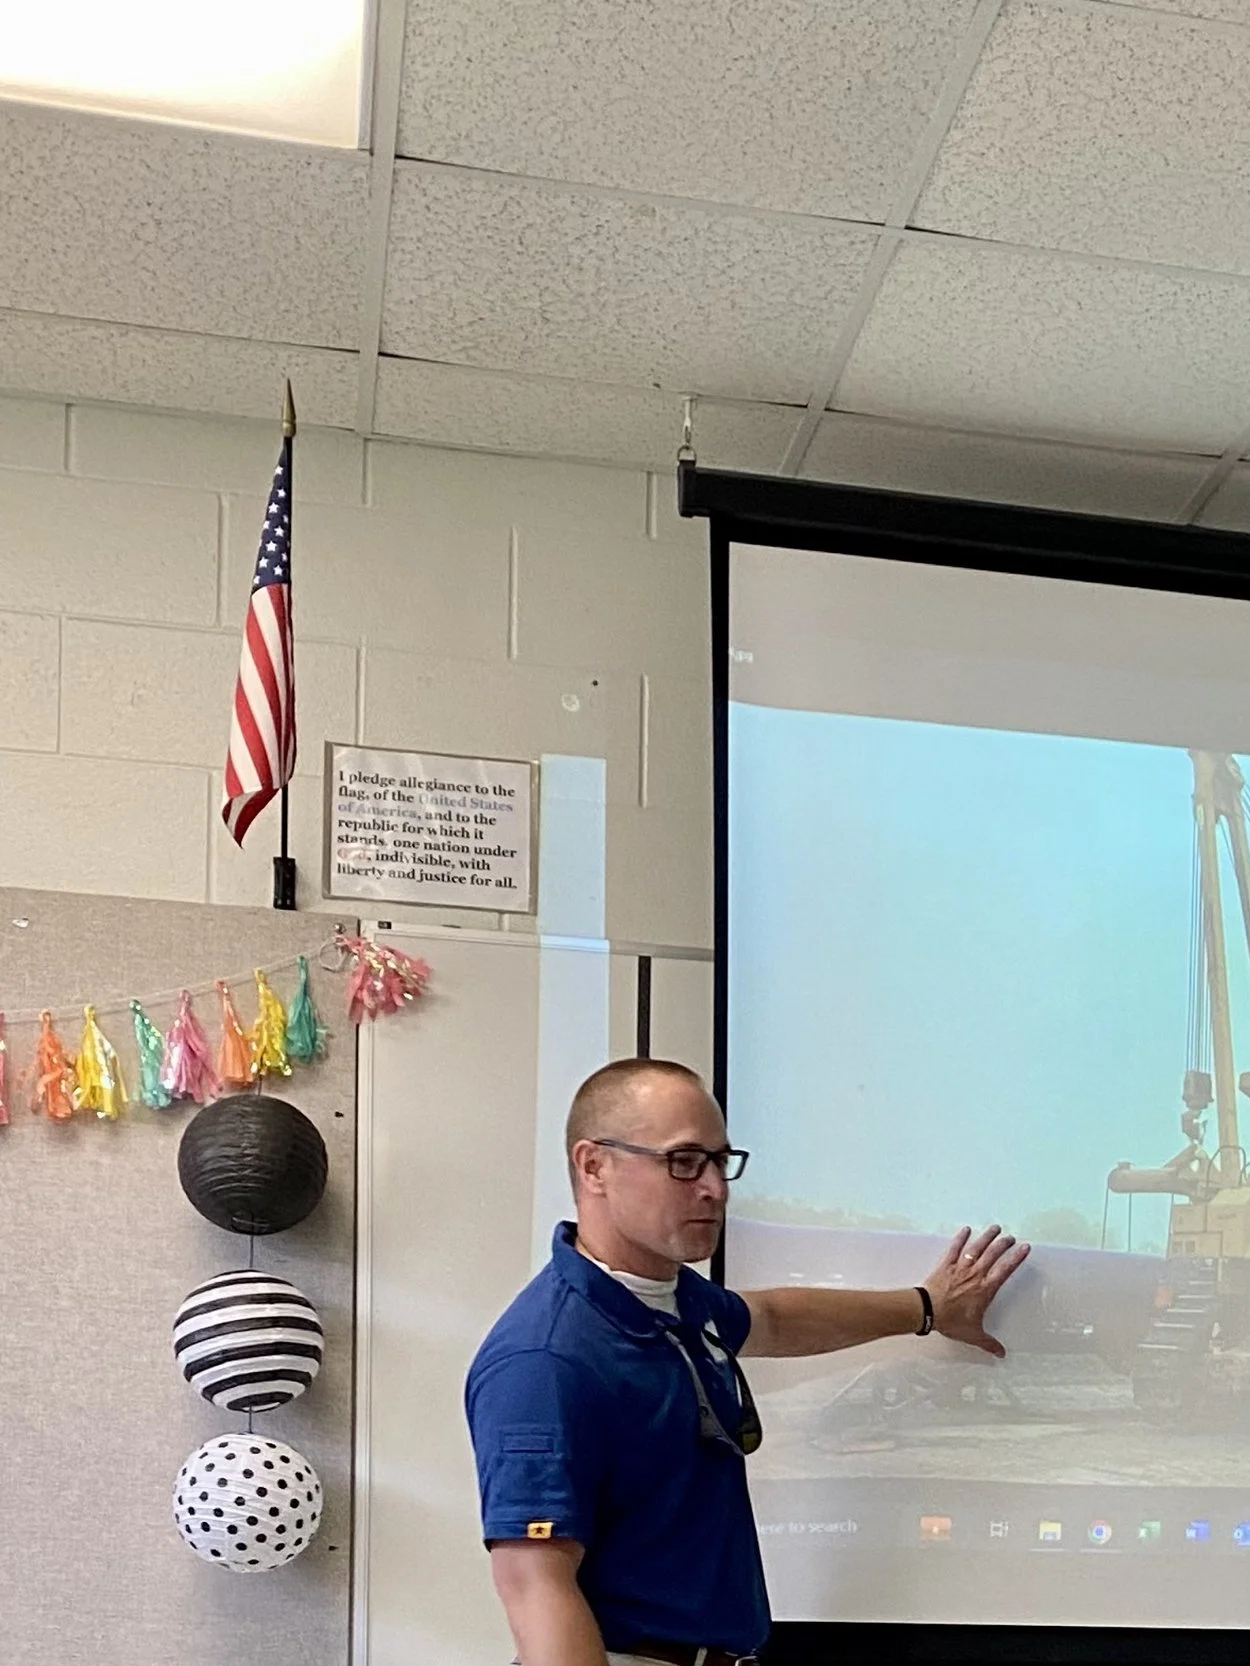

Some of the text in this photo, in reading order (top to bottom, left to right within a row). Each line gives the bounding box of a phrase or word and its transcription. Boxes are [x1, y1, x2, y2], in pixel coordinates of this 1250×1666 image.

[338, 770, 515, 798] I pledge allegiance to the
[373, 789, 389, 801] of
[391, 790, 414, 803] the
[418, 793, 467, 808] United
[469, 797, 514, 812] States
[337, 801, 353, 814] of
[424, 810, 452, 823] and
[456, 812, 471, 825] to
[474, 812, 497, 826] the
[337, 818, 484, 840] republic for which it
[336, 848, 491, 871] Gd, indivisible, with
[393, 838, 421, 849] one
[423, 841, 470, 855] nation
[473, 845, 517, 859] under
[336, 862, 518, 890] liberty and justice for all.
